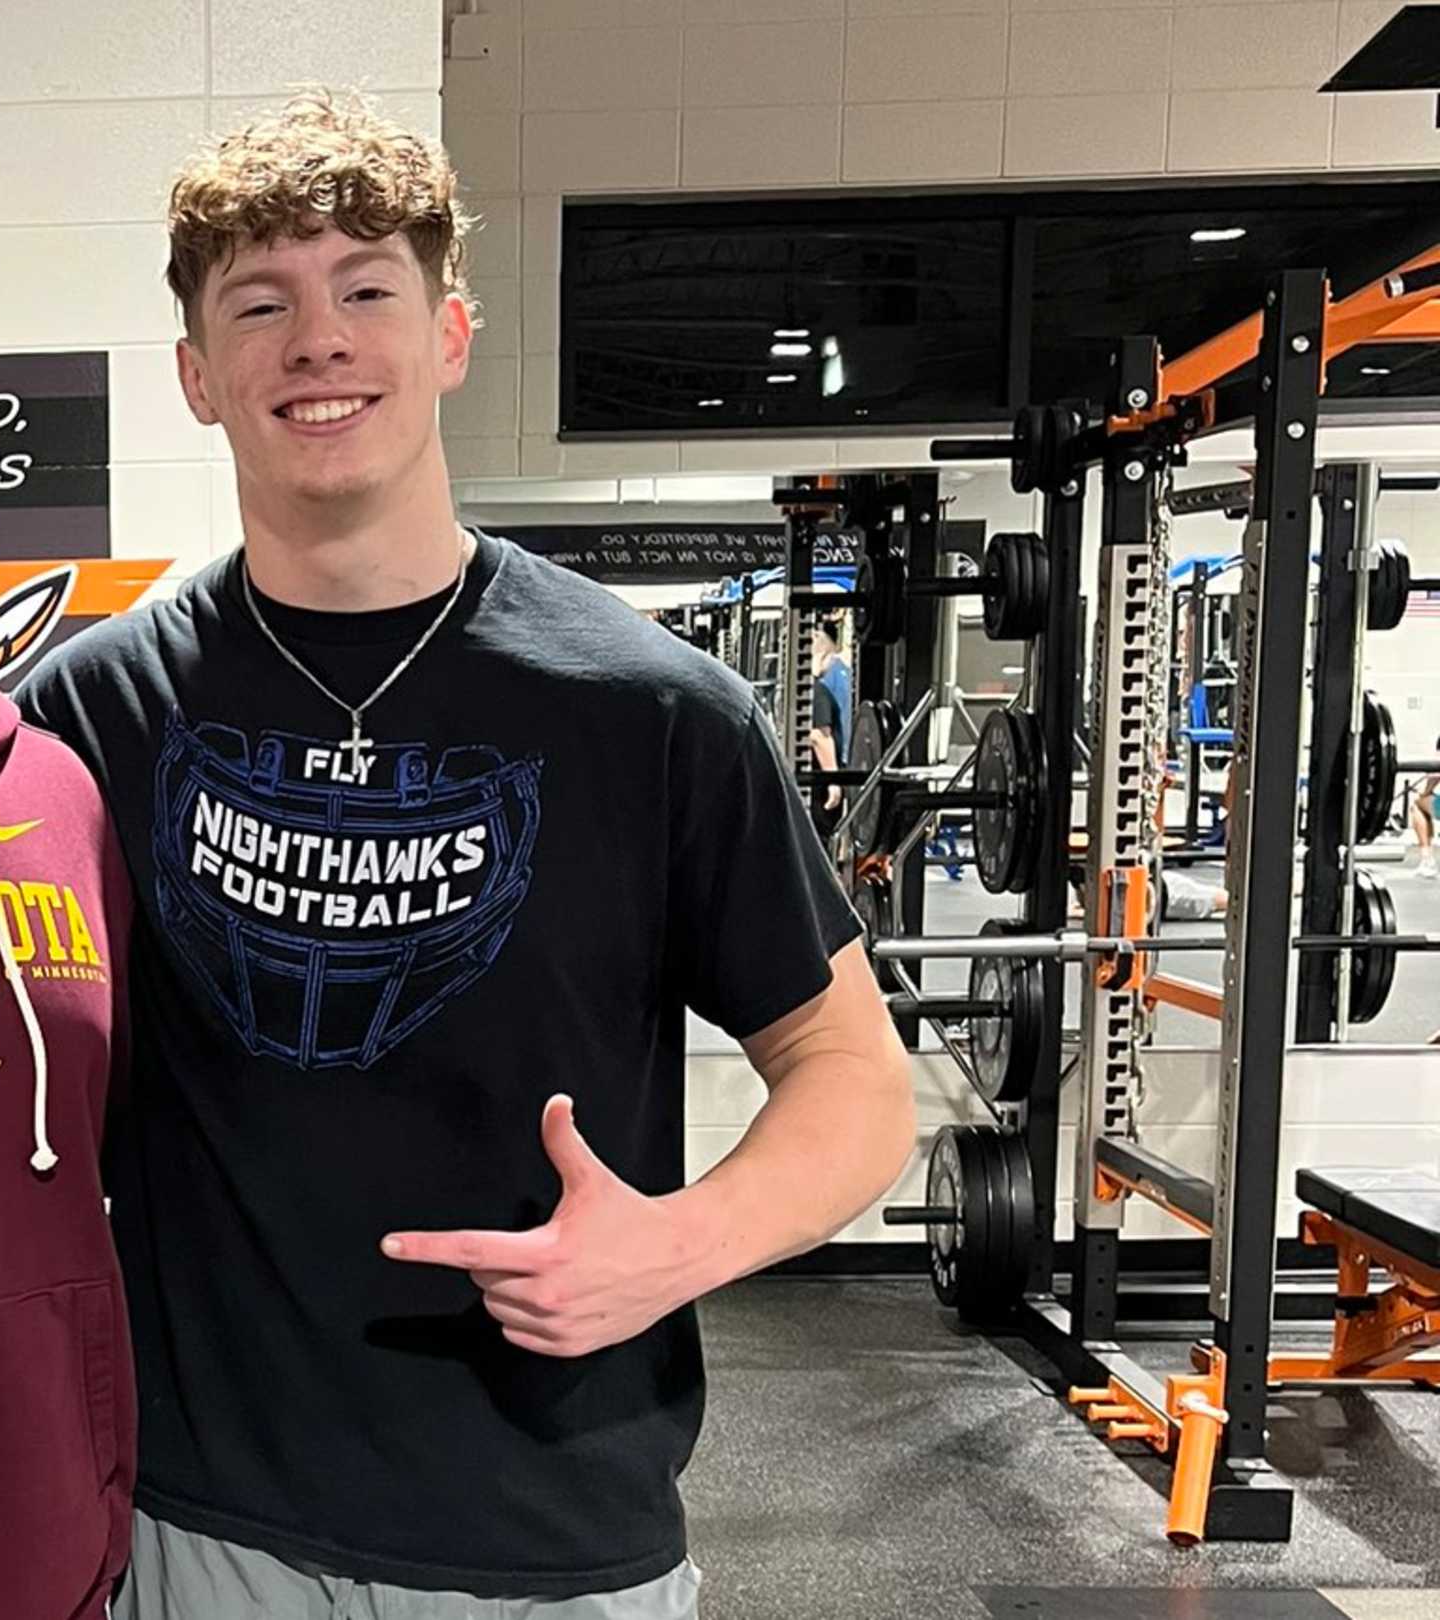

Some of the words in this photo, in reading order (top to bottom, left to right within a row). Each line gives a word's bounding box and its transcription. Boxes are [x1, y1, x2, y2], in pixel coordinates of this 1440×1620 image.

[304, 748, 377, 785] FLY
[192, 791, 487, 885] NIGHTHAWKS
[191, 840, 472, 928] FOOTBALL
